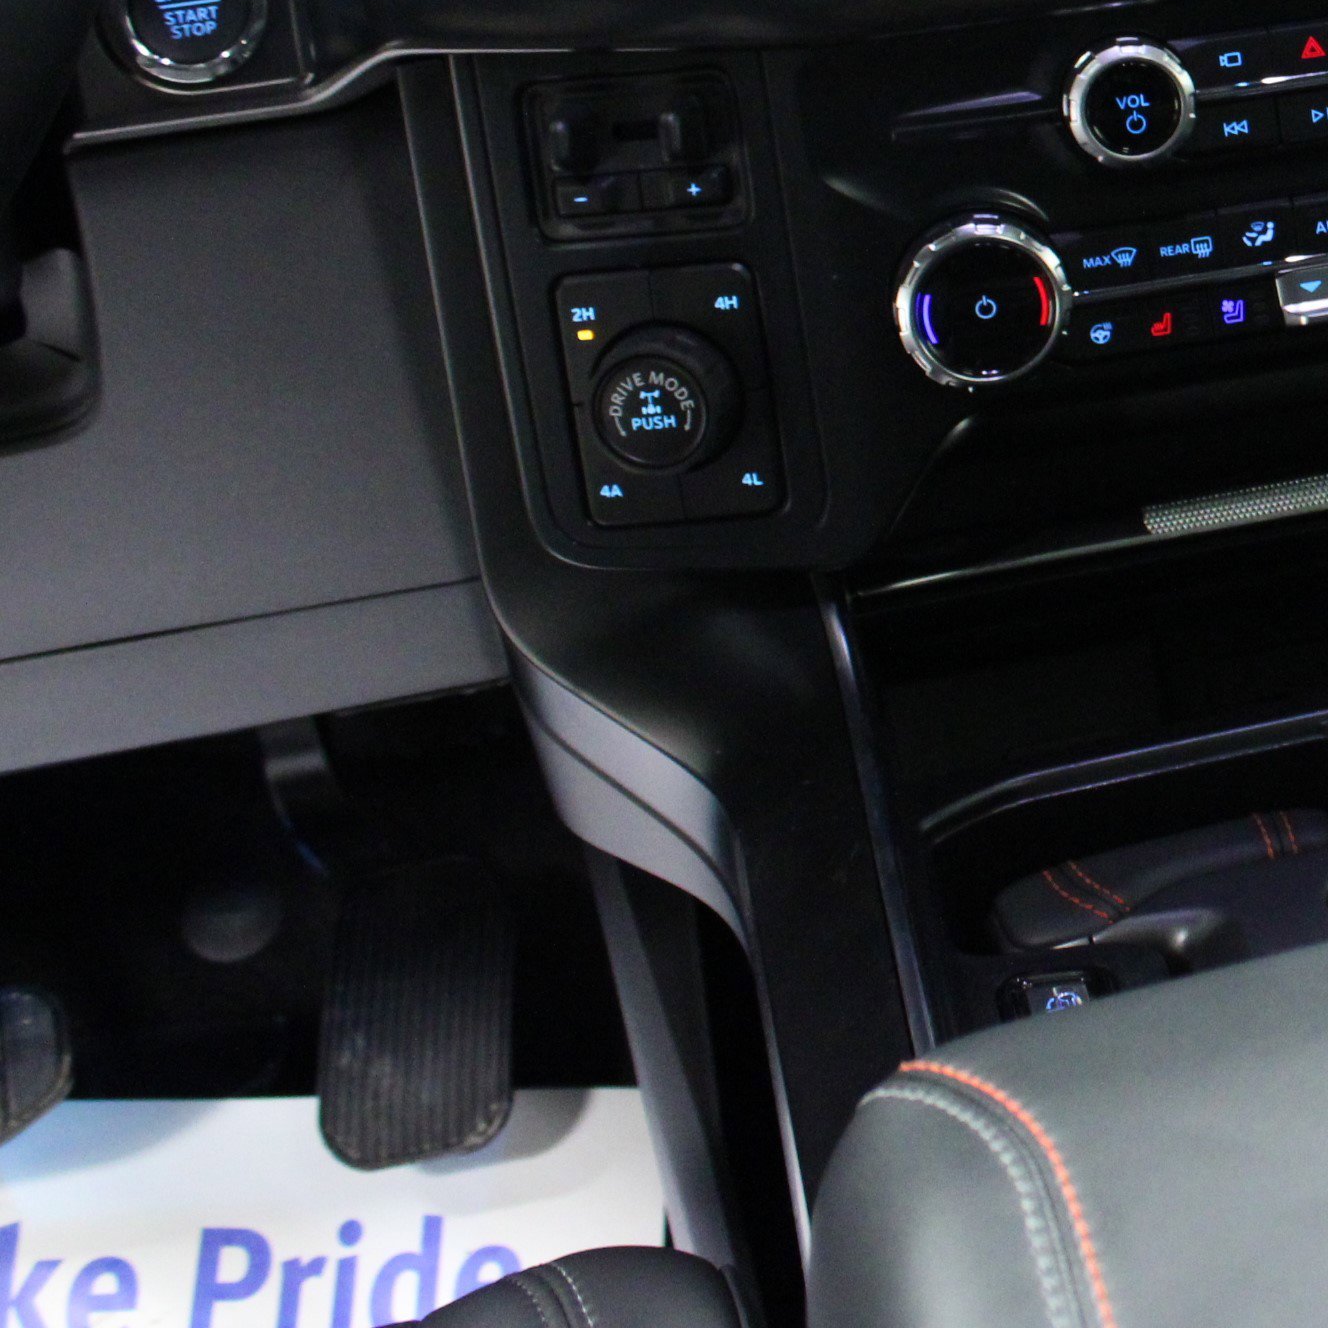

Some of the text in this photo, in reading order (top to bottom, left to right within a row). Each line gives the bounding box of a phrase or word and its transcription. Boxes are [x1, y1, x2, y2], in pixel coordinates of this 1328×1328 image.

[163, 5, 219, 25] START
[170, 21, 218, 40] STOP
[1115, 93, 1150, 110] VOL
[1159, 243, 1191, 258] REAR
[1083, 253, 1112, 269] MAX
[714, 295, 739, 310] 4H
[571, 307, 596, 323] 2H
[608, 371, 695, 418] DRIVE MODE
[631, 415, 677, 431] PUSH
[741, 472, 764, 486] 4L
[600, 484, 624, 498] 4A
